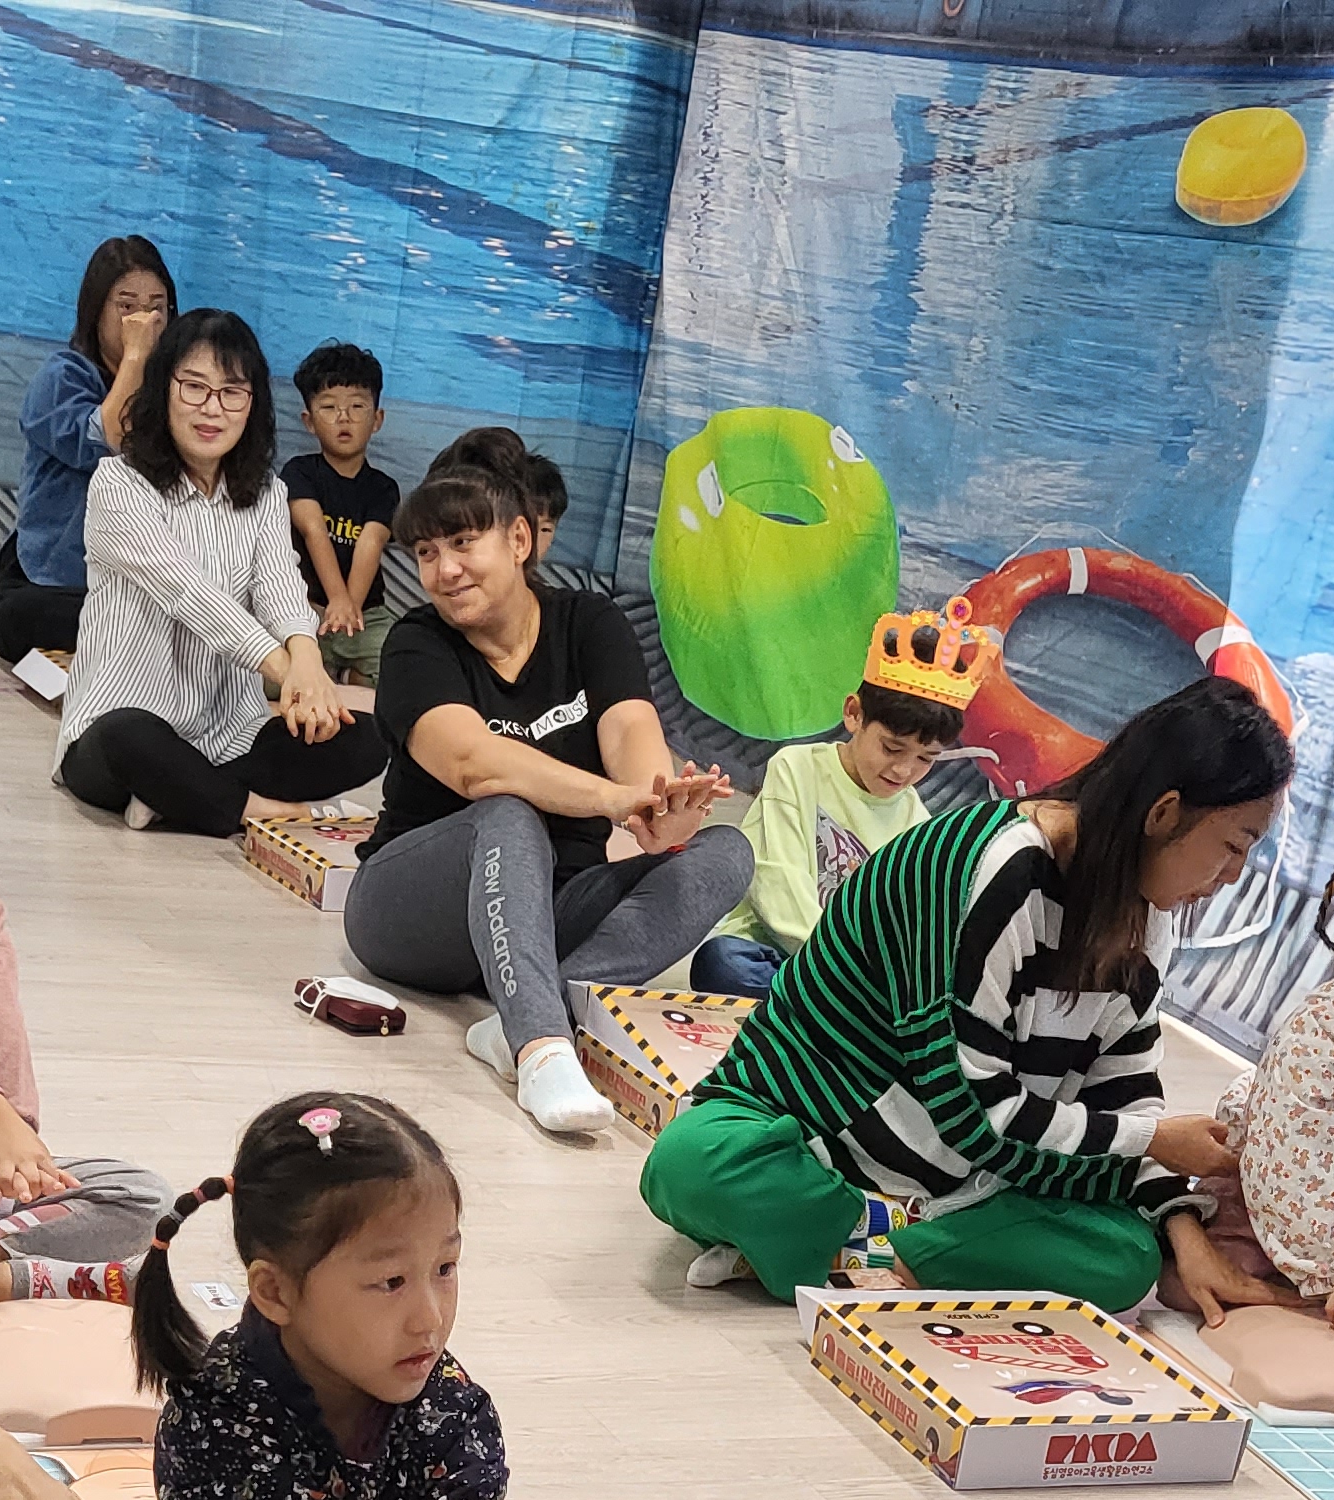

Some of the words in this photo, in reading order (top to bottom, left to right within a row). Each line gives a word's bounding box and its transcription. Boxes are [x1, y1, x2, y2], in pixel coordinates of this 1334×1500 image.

[483, 718, 530, 739] CKEY
[484, 845, 502, 895] new
[486, 894, 518, 999] balance
